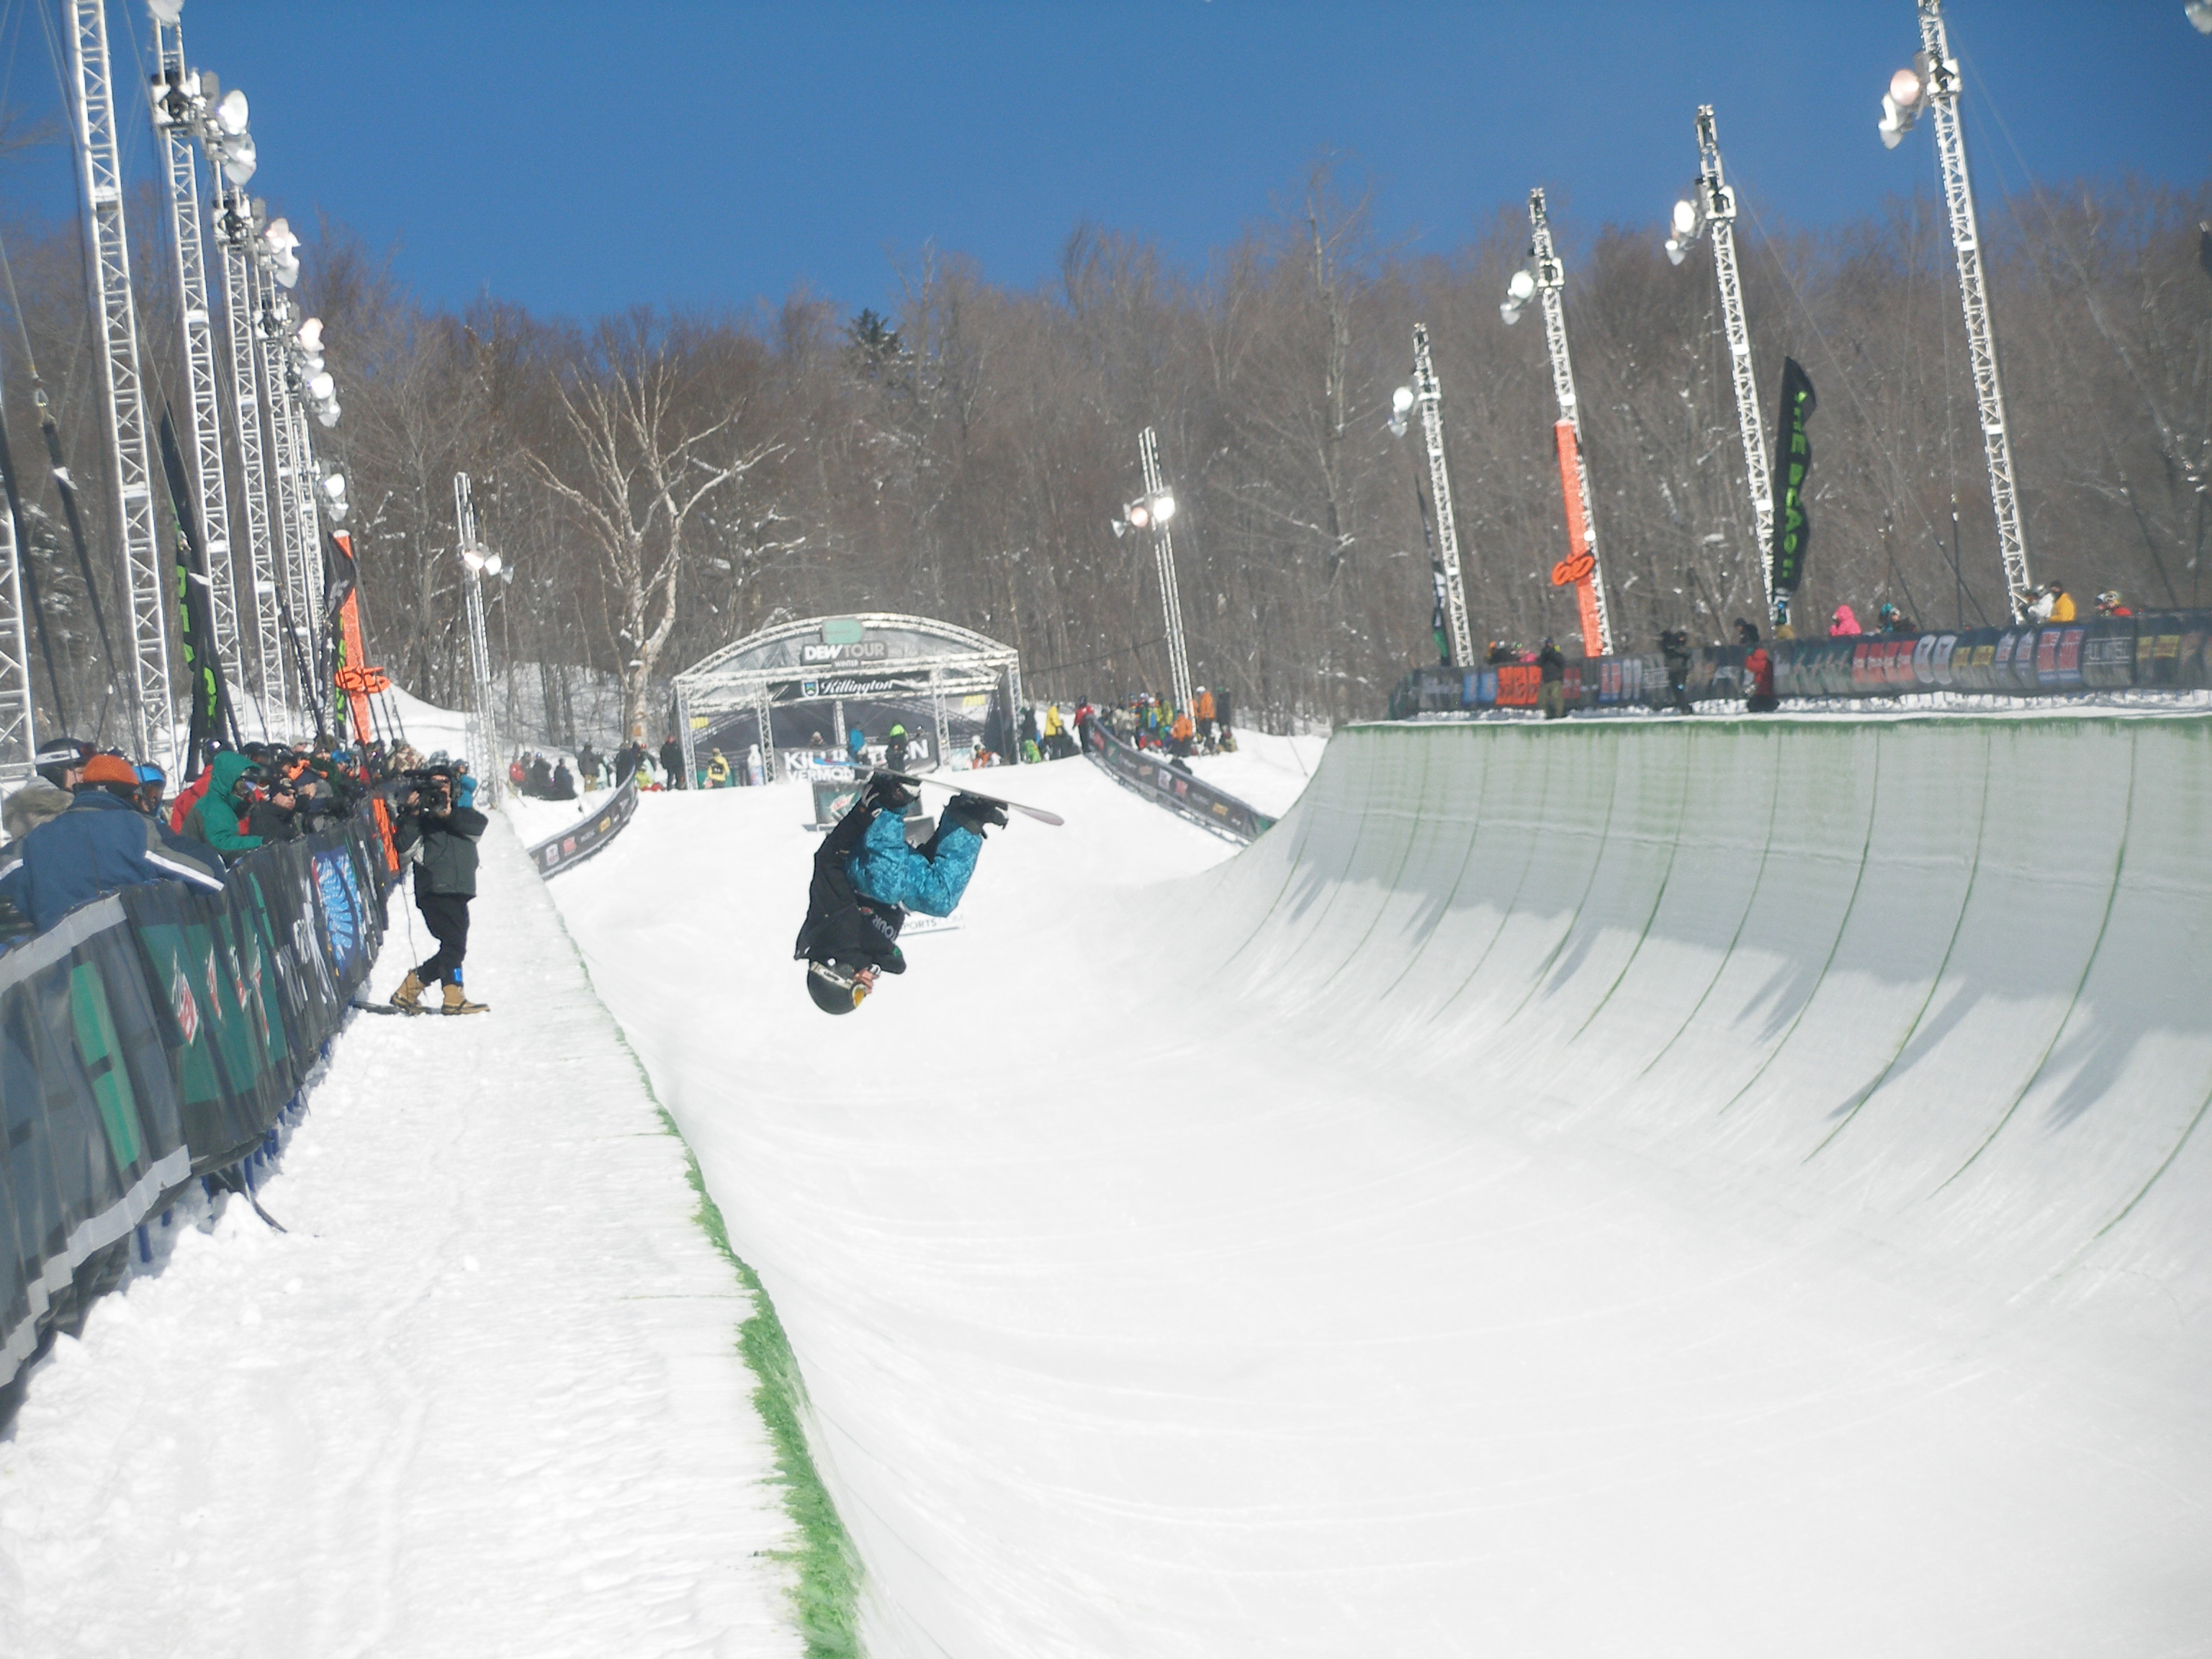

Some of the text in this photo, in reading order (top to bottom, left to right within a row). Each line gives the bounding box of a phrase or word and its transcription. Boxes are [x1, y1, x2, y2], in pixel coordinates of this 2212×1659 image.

[804, 642, 885, 660] DEW TOUR
[835, 659, 859, 667] WINTER
[821, 679, 894, 696] Killington
[786, 767, 856, 783] VERMON
